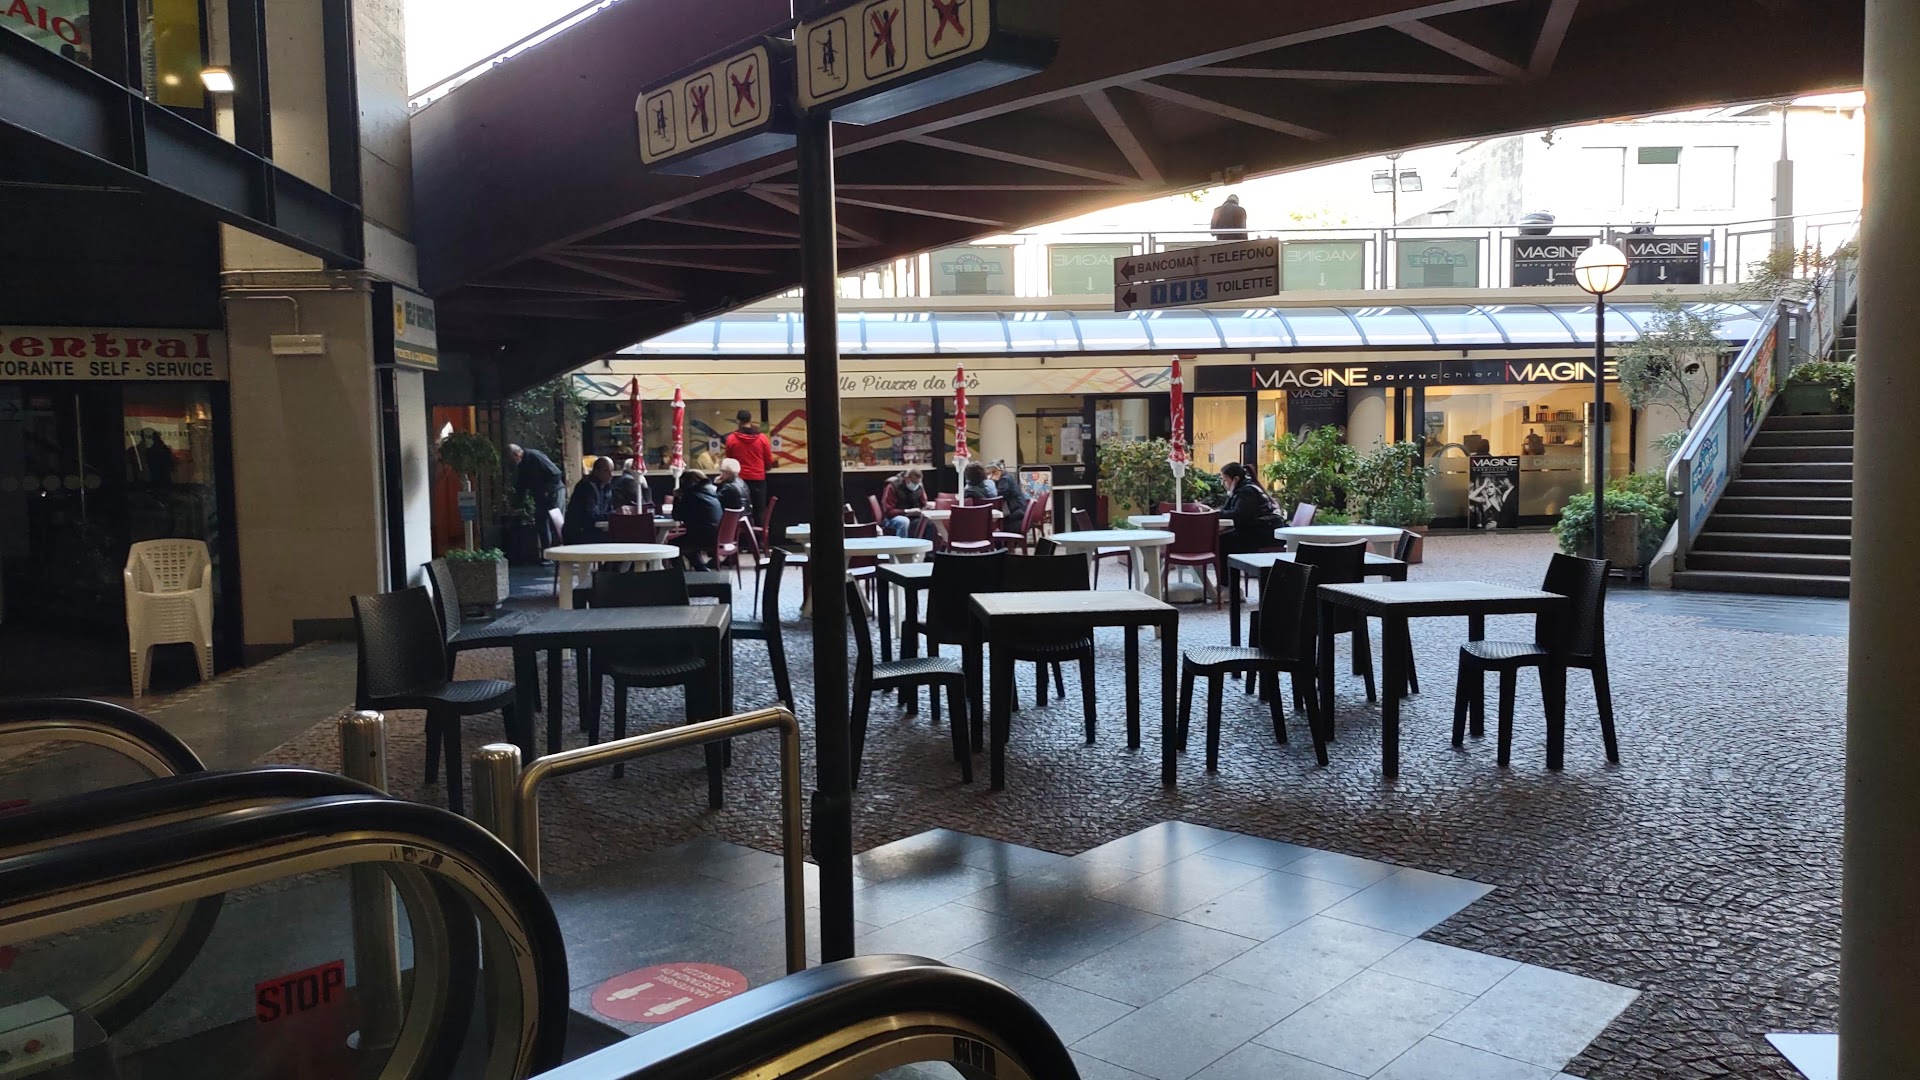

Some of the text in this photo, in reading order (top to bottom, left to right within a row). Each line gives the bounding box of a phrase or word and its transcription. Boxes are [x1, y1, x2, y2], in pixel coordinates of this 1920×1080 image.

[0, 0, 82, 46] AIO
[1137, 255, 1200, 273] BANCOMAT
[1210, 246, 1275, 265] TELEFONO
[1216, 276, 1273, 293] TOILETTE
[0, 331, 211, 359] entral
[90, 361, 130, 376] SELF
[146, 361, 213, 377] SERVICE
[1251, 366, 1369, 389] iMAGINE
[1373, 371, 1500, 382] parrucchieri
[785, 376, 806, 392] Ba
[862, 375, 917, 391] Piazze
[923, 375, 946, 390] da
[257, 967, 342, 1023] STOP
